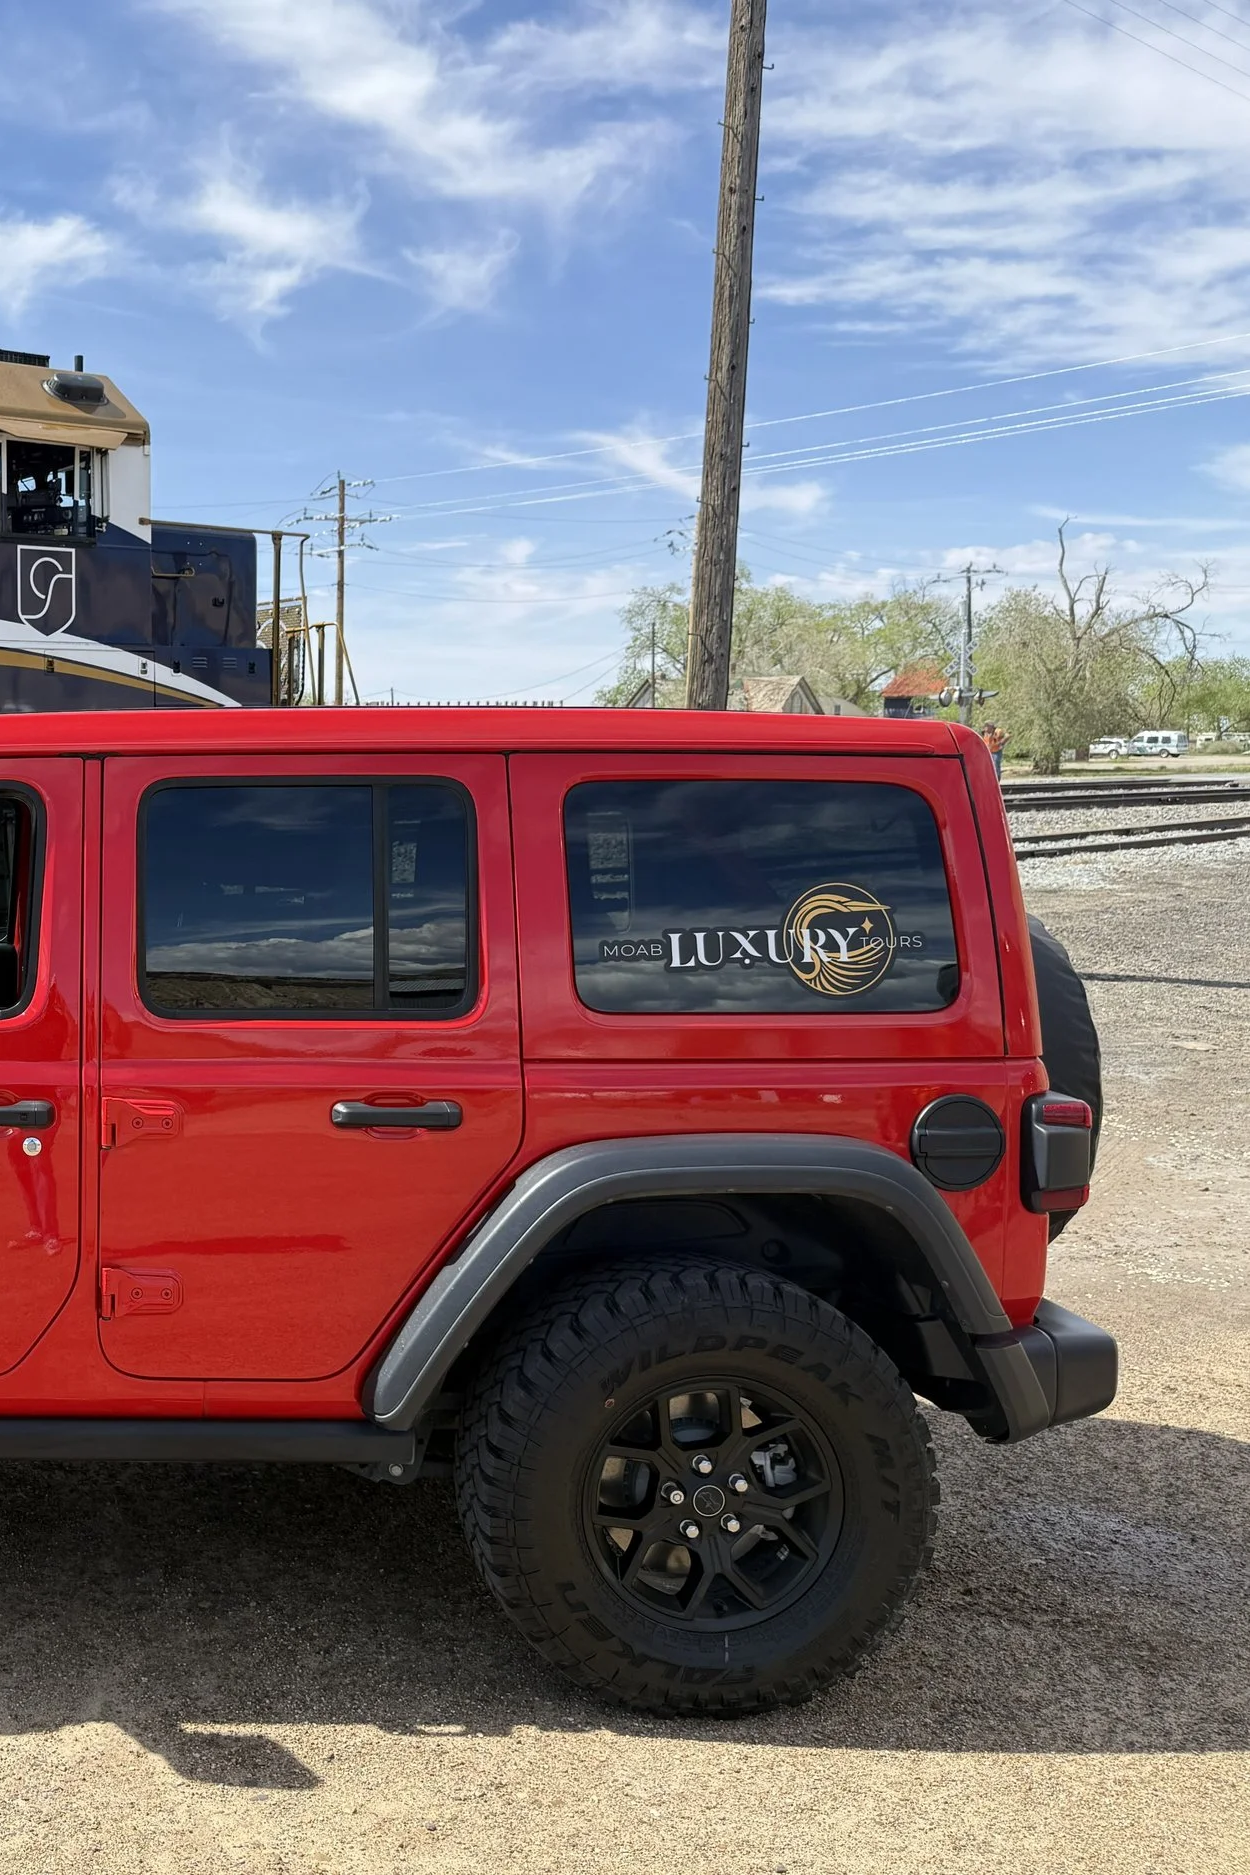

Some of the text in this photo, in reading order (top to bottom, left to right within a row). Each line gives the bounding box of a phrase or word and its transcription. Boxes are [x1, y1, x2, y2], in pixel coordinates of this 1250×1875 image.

[603, 926, 923, 968] MOAB LUXURY TOURS
